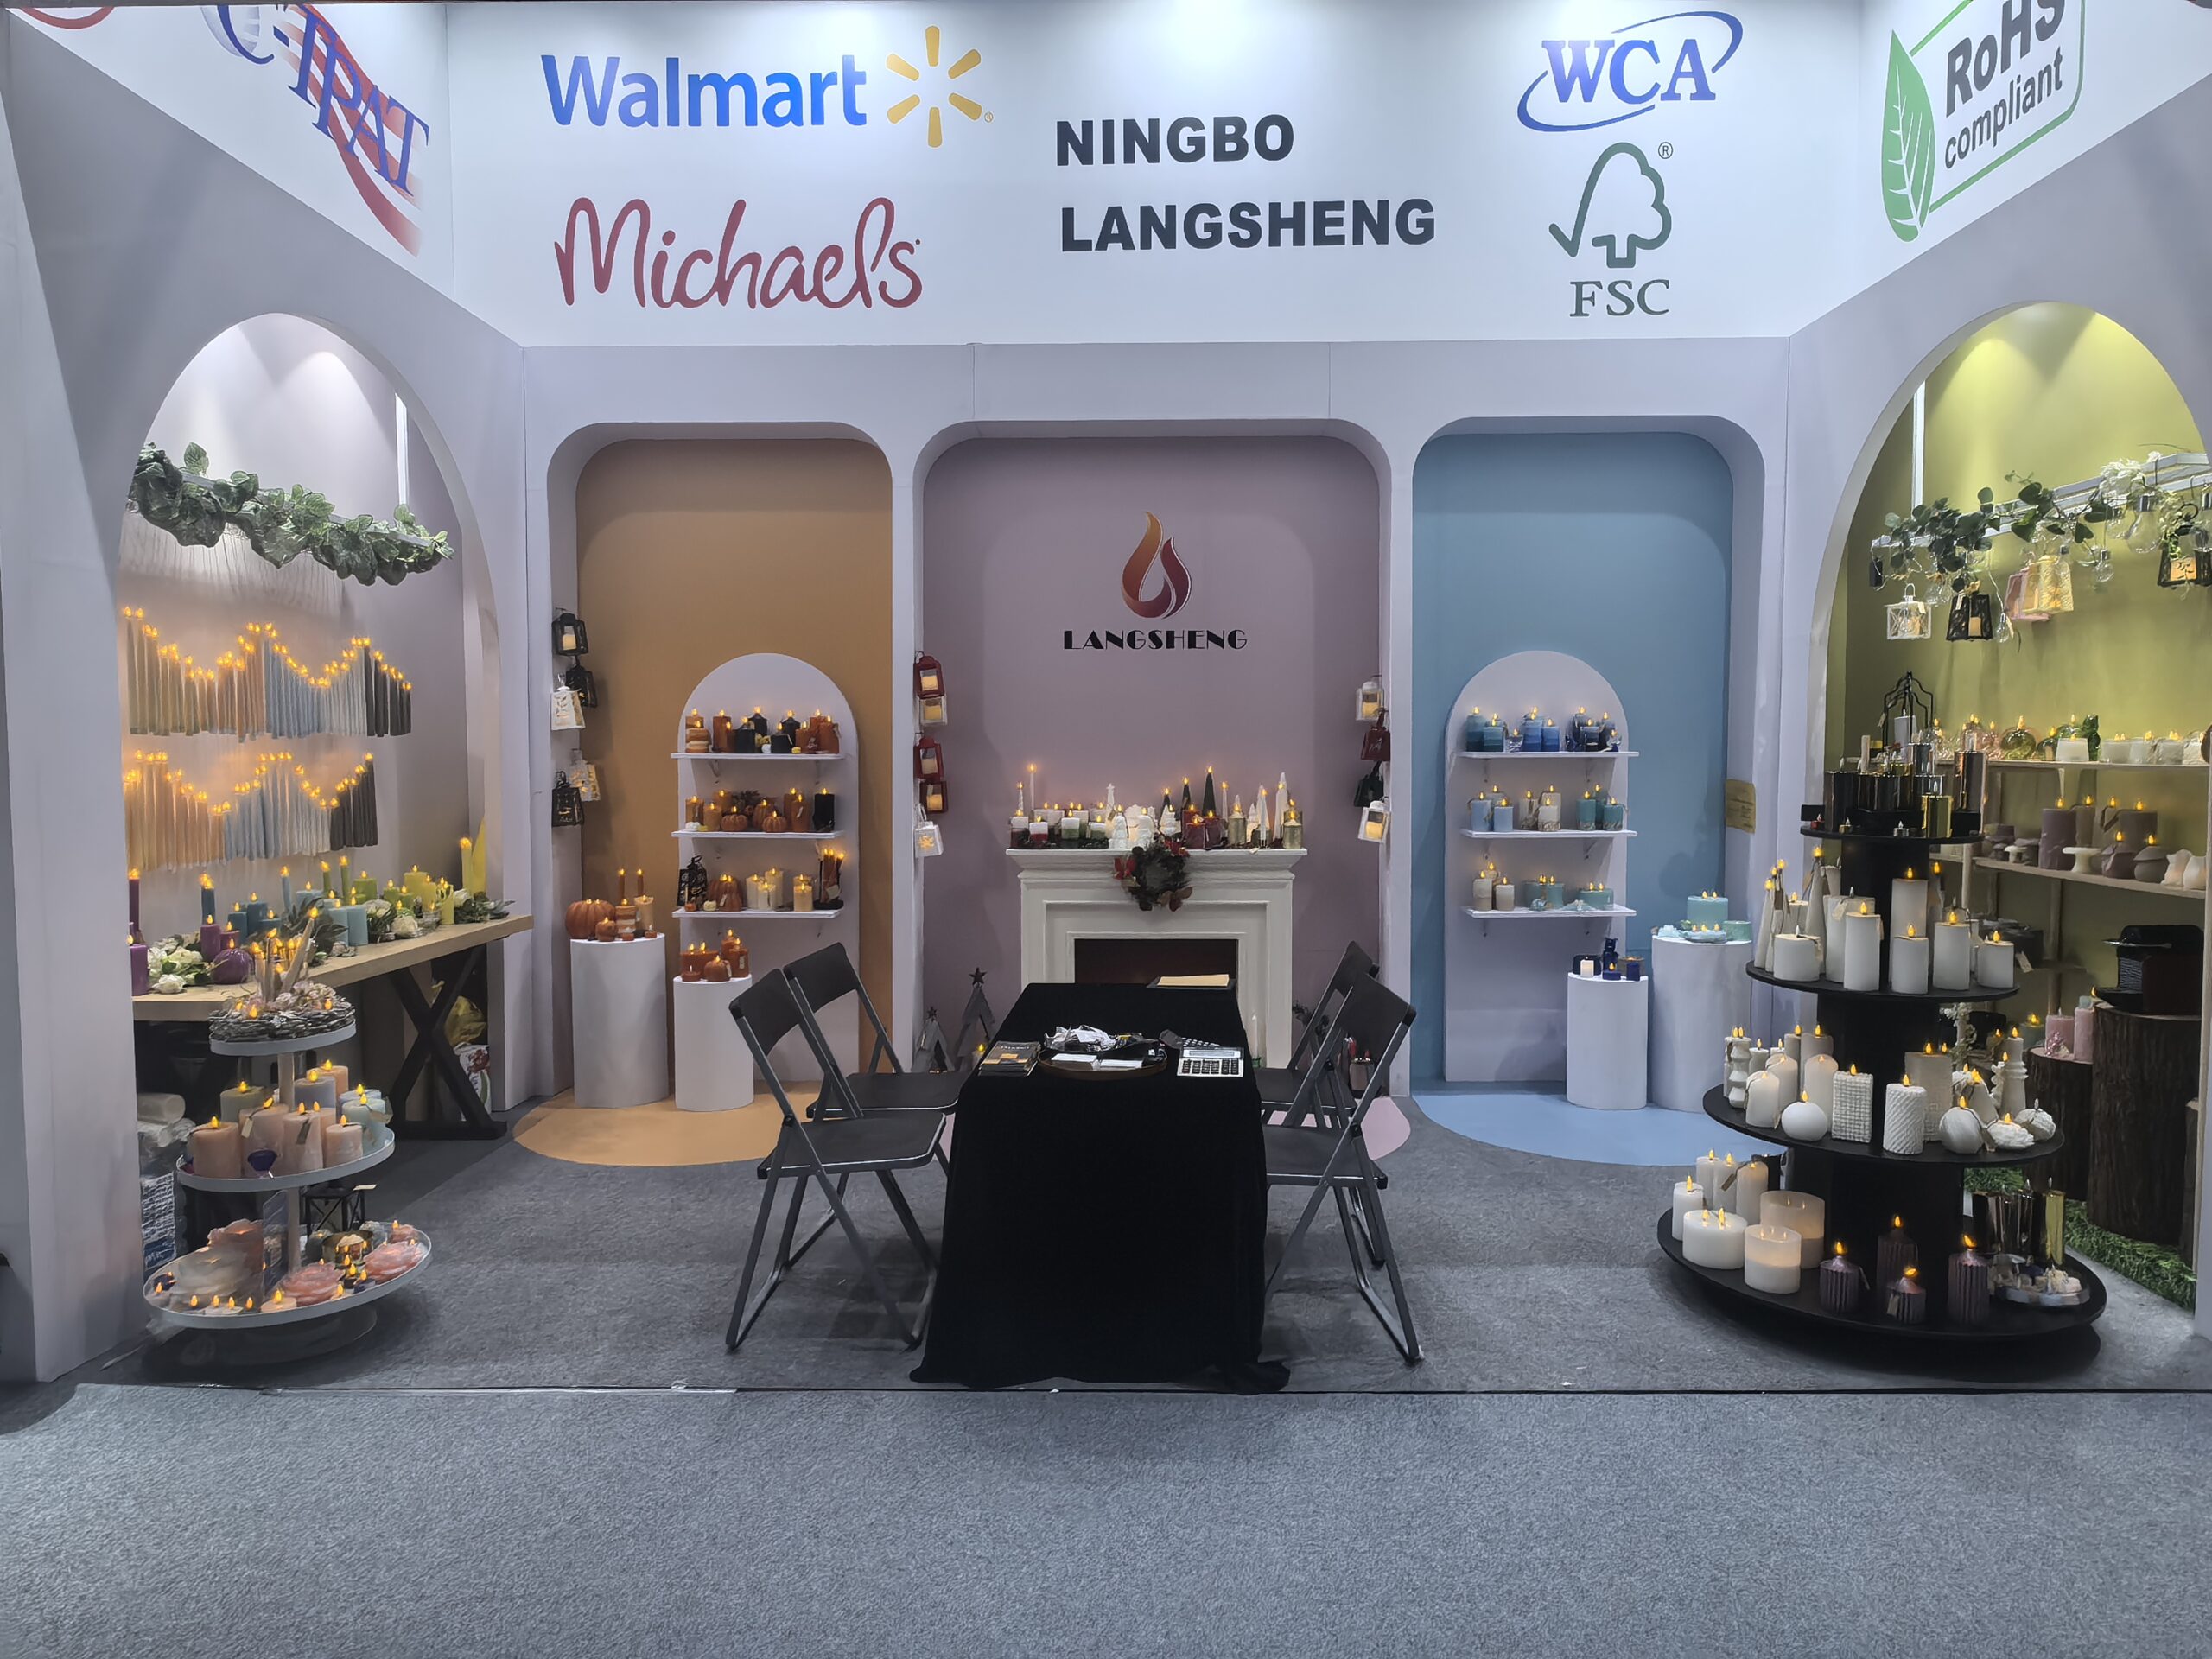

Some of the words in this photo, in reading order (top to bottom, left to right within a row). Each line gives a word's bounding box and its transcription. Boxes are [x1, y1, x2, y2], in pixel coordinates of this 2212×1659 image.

[542, 54, 867, 127] Walmart
[1541, 39, 1715, 103] WCA
[1944, 46, 2063, 169] compliant
[1056, 114, 1294, 166] NINGBO
[554, 197, 923, 308] Michaels
[1061, 198, 1435, 251] LANGSHENG
[1570, 279, 1670, 317] FSC
[1064, 629, 1248, 650] LANGSHENG
